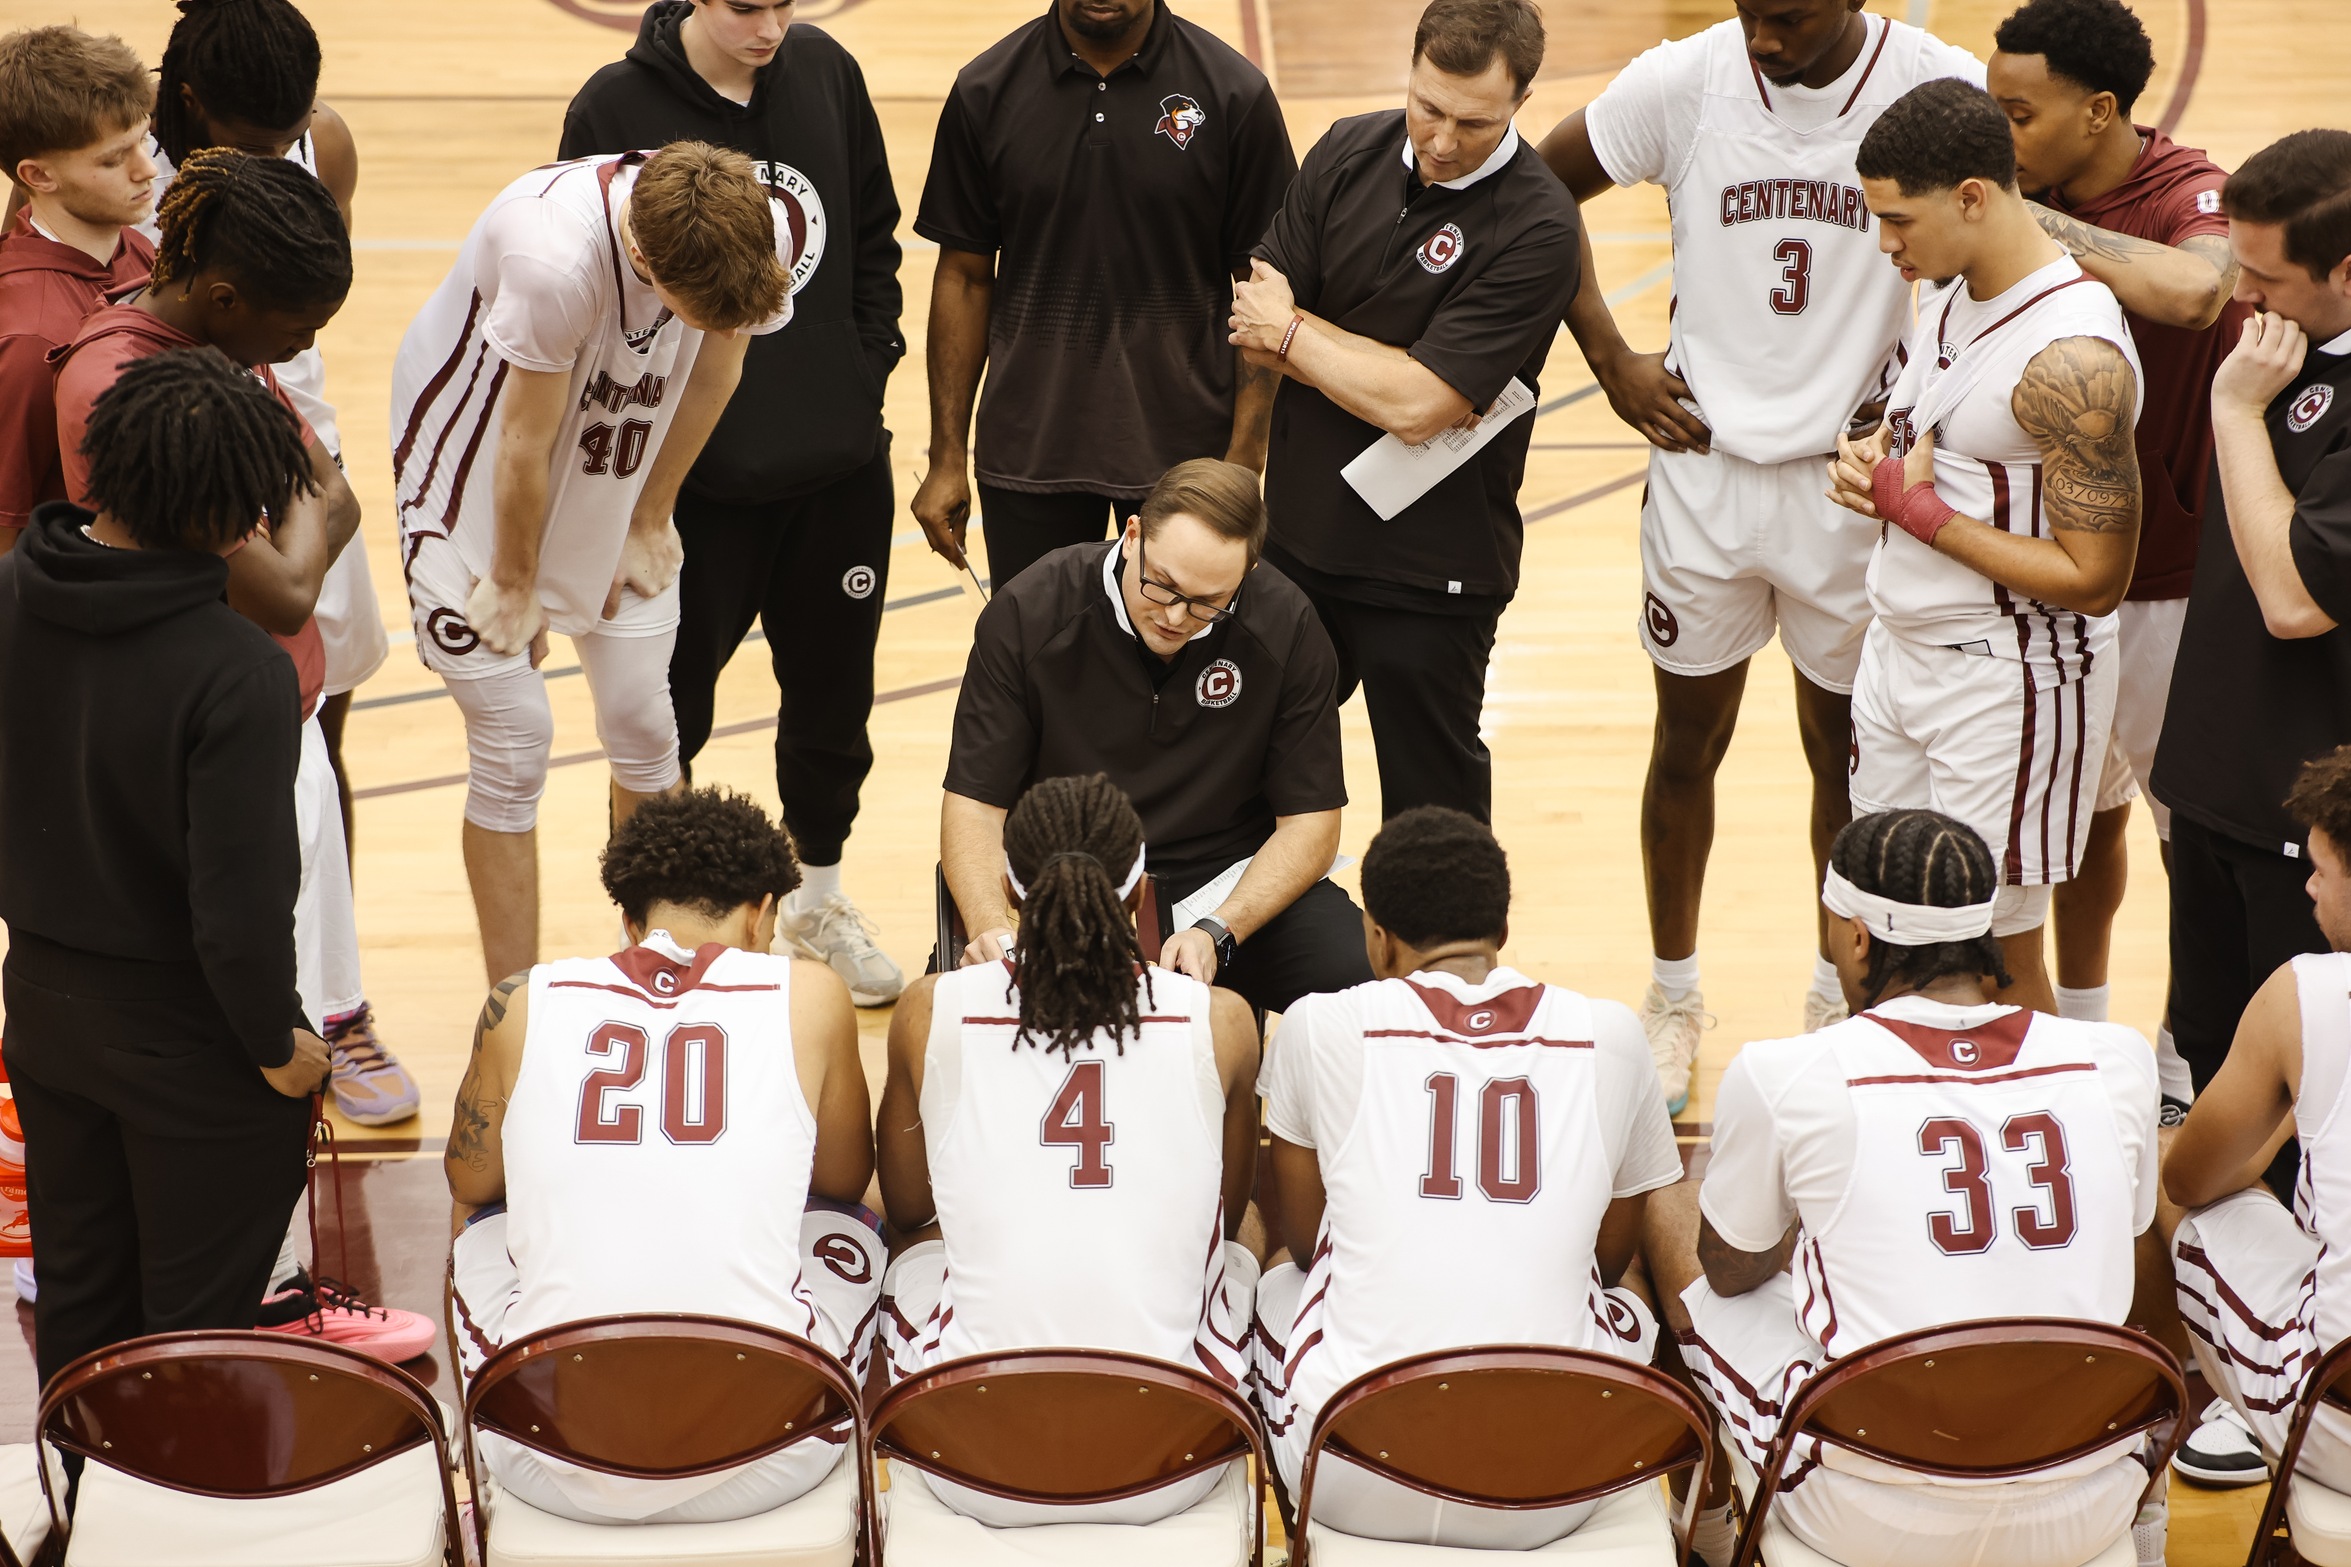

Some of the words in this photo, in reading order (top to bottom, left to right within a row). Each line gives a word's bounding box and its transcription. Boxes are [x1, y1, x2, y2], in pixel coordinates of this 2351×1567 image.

[1720, 179, 1870, 232] CENTENARY
[1429, 234, 1454, 262] C
[1769, 238, 1812, 316] 3
[2297, 393, 2323, 420] C
[578, 417, 654, 480] 40
[852, 573, 868, 591] C
[1207, 671, 1228, 696] C
[654, 971, 675, 994] C
[1469, 1011, 1491, 1029] C
[1952, 1042, 1976, 1063] C
[574, 1020, 729, 1146] 20
[1039, 1059, 1115, 1190] 4
[1419, 1071, 1542, 1205] 10
[1916, 1109, 2079, 1257] 33
